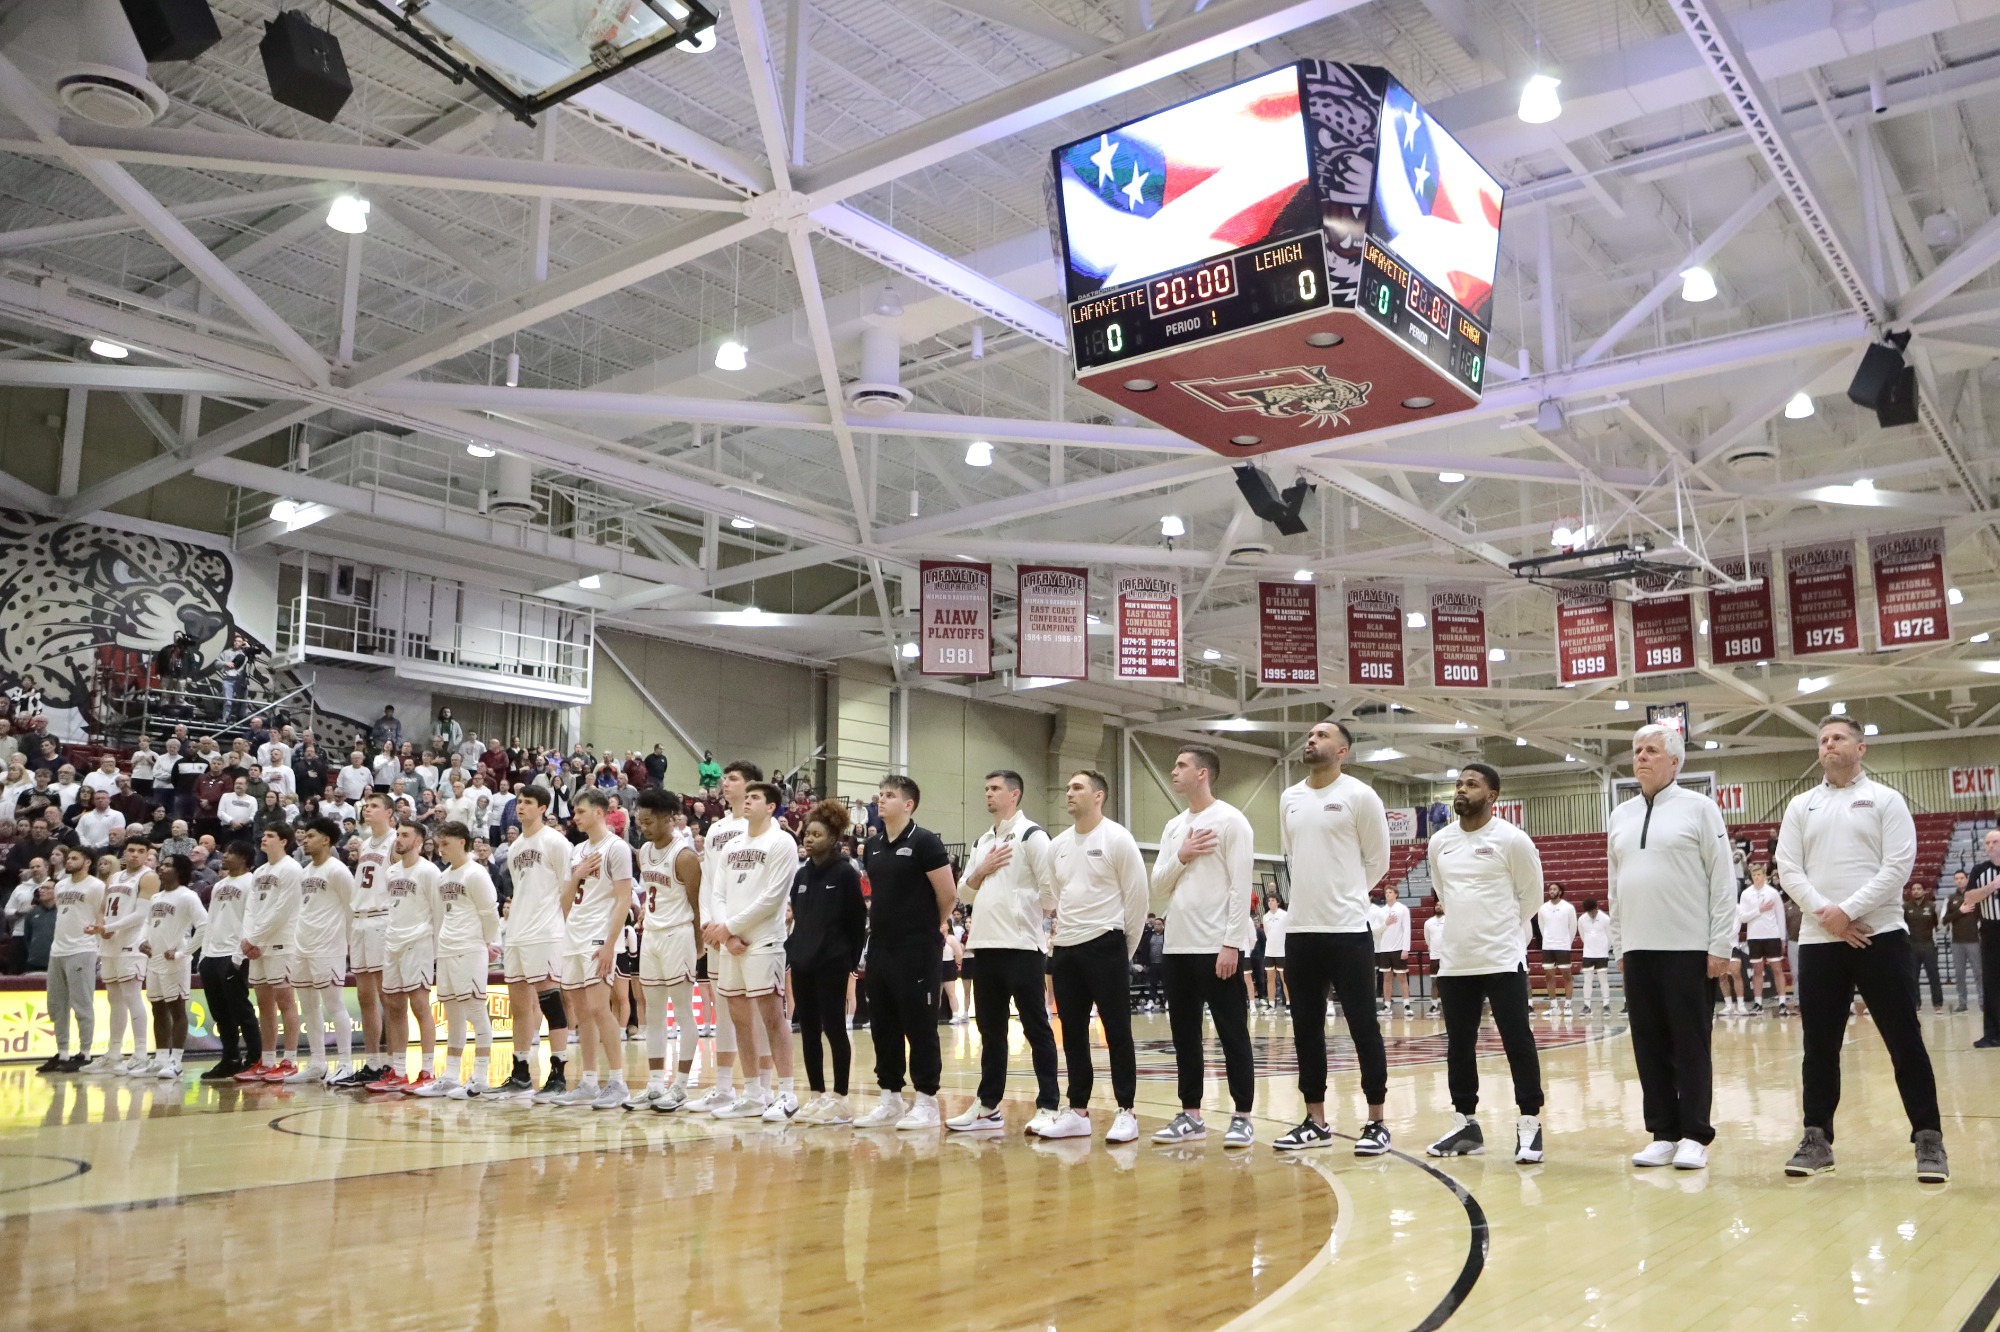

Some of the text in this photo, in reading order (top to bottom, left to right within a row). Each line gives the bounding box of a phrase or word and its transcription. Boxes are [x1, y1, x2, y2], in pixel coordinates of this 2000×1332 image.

[1255, 242, 1303, 272] LEHIGH
[1364, 241, 1408, 289] LAFAYETTE
[1155, 264, 1231, 310] 20:00
[1298, 269, 1317, 301] 0
[1077, 285, 1119, 300] DAKTRONICS
[1378, 284, 1390, 315] 0
[1072, 289, 1145, 324] LAFAYETTE
[1165, 310, 1217, 337] PERIOD 1
[1106, 323, 1123, 352] 0
[1409, 323, 1428, 345] PERIOD
[1472, 355, 1481, 383] 0
[925, 568, 987, 587] LAFAYETTE
[1022, 573, 1084, 592] LAFAYETTE
[1888, 578, 1932, 591] NATIONAL
[1118, 577, 1178, 595] LAFAYETTE
[1276, 588, 1299, 597] FRAN
[1347, 589, 1401, 606] LAFAYETTE
[1432, 592, 1482, 609] LAFAYETTE
[1801, 588, 1842, 601] NATIONAL
[1886, 589, 1936, 603] INVITATION
[1266, 597, 1309, 607] O'HANLON
[1721, 600, 1760, 611] NATIONAL
[1799, 599, 1847, 612] INVITATION
[1881, 599, 1942, 615] TOURNAMENT
[934, 609, 978, 625] AIAW
[1126, 610, 1170, 619] EAST COAST
[1578, 606, 1607, 616] BASKETBALL
[1718, 609, 1764, 622] INVITATION
[1795, 609, 1853, 624] TOURNAMENT
[1030, 615, 1076, 623] CONFERENCE
[1125, 619, 1171, 628] CONFERENCE
[1577, 618, 1594, 626] NCAA
[1636, 619, 1662, 629] PATRIOT
[928, 627, 984, 640] PLAYOFFS
[1031, 624, 1075, 632] CHAMPIONS
[1128, 627, 1169, 636] CHAMPIONS
[1367, 623, 1384, 631] NCAA
[1564, 624, 1608, 636] TOURNAMENT
[1714, 620, 1769, 634] TOURNAMENT
[1894, 617, 1935, 638] 1972
[1055, 635, 1082, 643] 1986-87
[1353, 631, 1397, 640] TOURNAMENT
[1438, 634, 1480, 642] TOURNAMENT
[1561, 634, 1614, 648] PATRIOT LEAGUE
[1645, 635, 1681, 644] CHAMPIONS
[1806, 627, 1845, 647] 1975
[1122, 647, 1175, 656] 1976-77 1977-78
[1350, 642, 1376, 650] PATRIOT
[1462, 645, 1485, 653] LEAGUE
[1569, 643, 1606, 655] CHAMPIONS
[1725, 637, 1761, 656] 1980
[939, 648, 973, 664] 1981
[1121, 657, 1147, 665] 1979-80
[1358, 650, 1394, 658] CHAMPIONS
[1647, 647, 1681, 666] 1998
[1361, 662, 1393, 679] 2015
[1444, 665, 1478, 680] 2000
[1572, 656, 1605, 675] 1999
[1265, 668, 1315, 680] 1995-2022
[1953, 769, 1994, 793] EXIT
[1716, 787, 1741, 809] XIT
[106, 896, 120, 917] 14
[649, 886, 657, 913] 3
